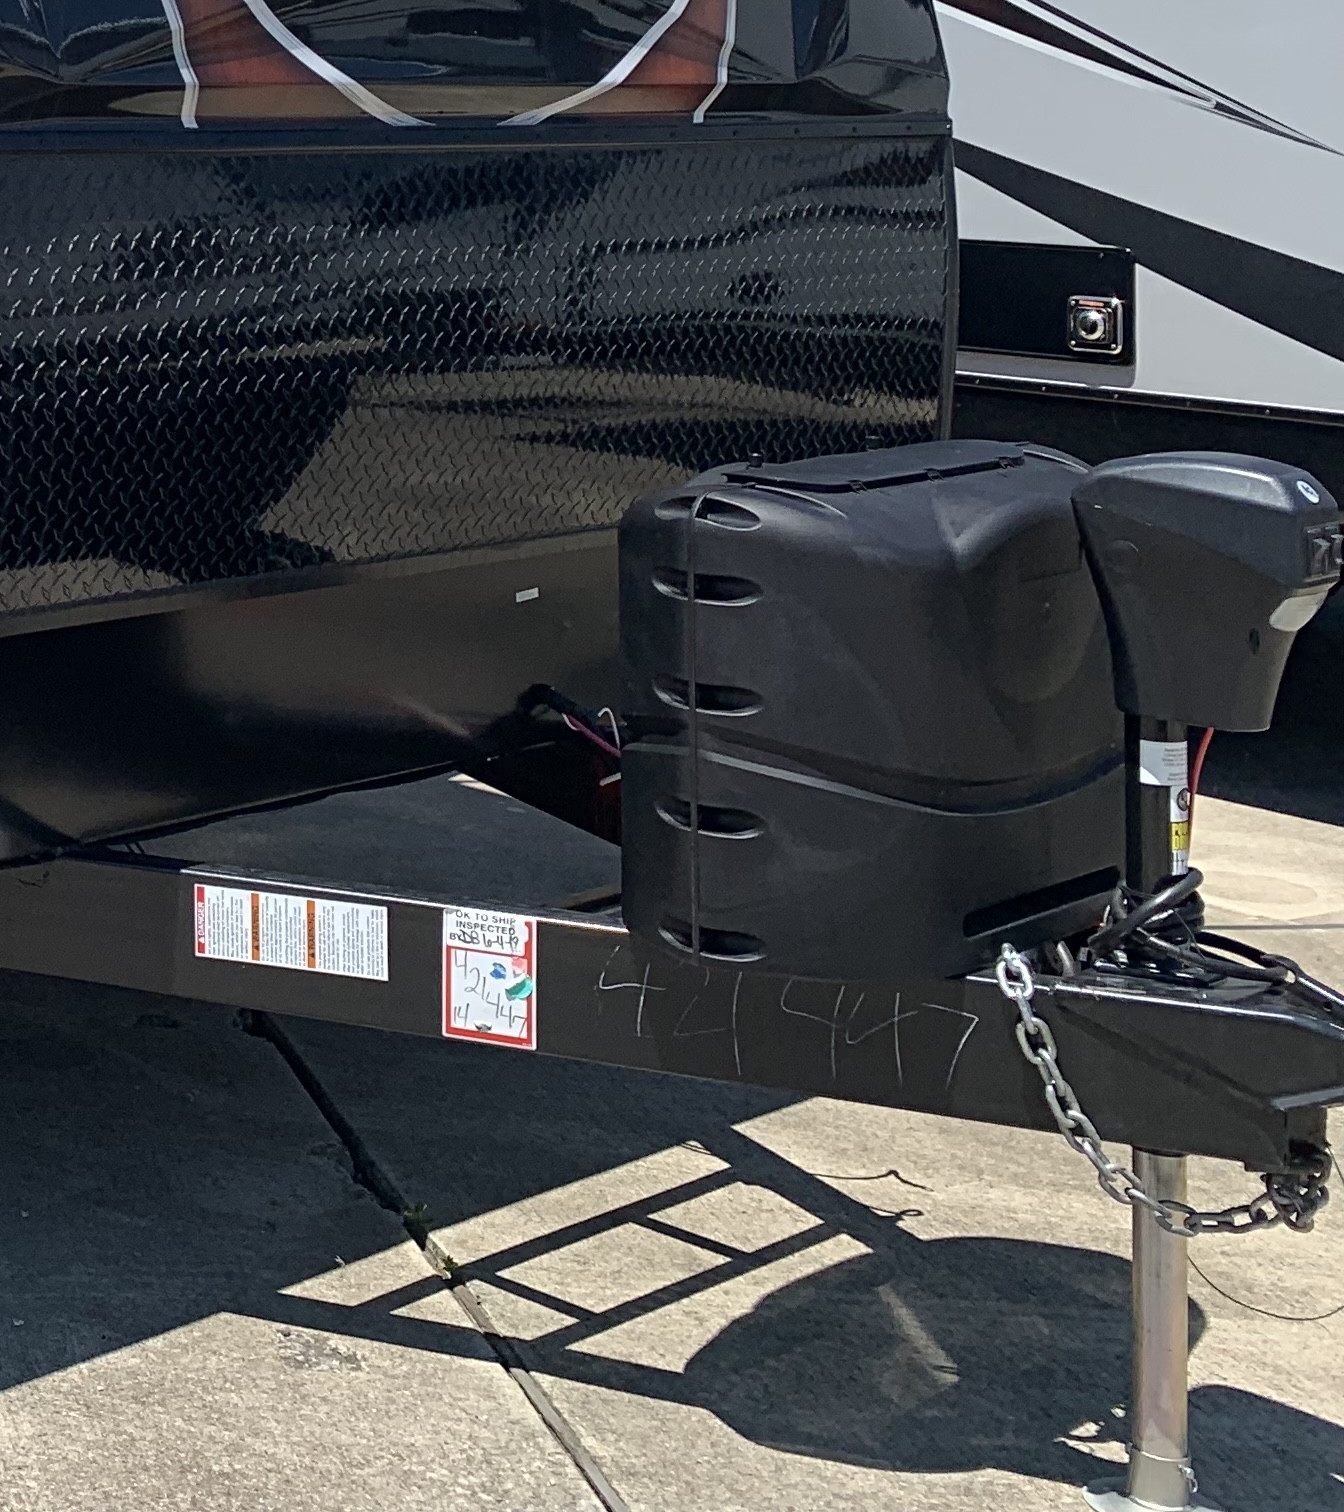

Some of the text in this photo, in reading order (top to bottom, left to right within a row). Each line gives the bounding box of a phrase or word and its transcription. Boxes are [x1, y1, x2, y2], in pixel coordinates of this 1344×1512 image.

[455, 909, 516, 926] OK TO SHIP
[455, 920, 516, 935] INSPECTED
